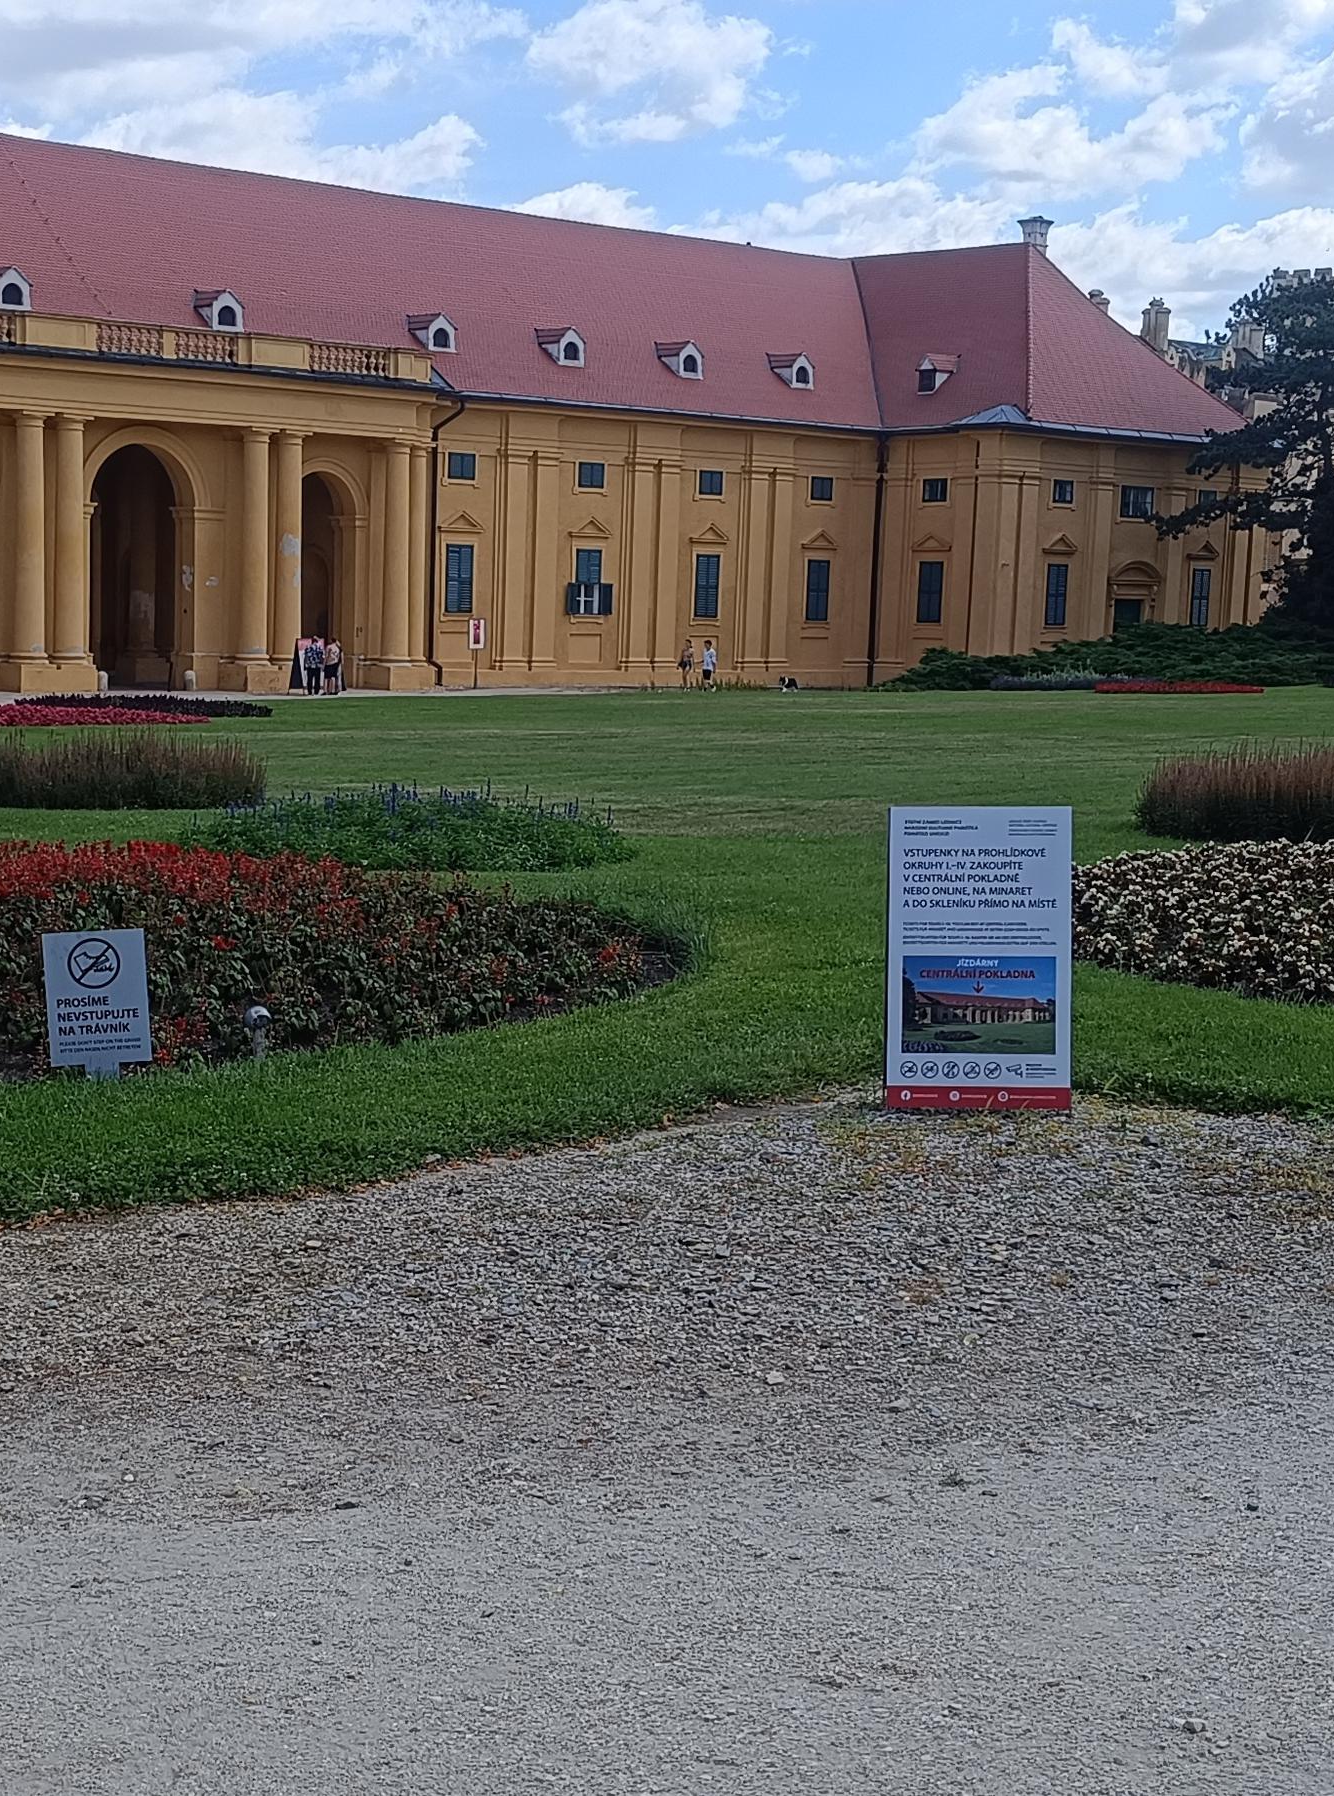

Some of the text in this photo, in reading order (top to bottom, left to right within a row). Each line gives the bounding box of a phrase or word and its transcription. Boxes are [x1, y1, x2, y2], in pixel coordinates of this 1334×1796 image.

[903, 847, 1046, 857] VSTUPENKY NA PROHLÍDKOVÉ
[903, 861, 944, 870] OKRUHY
[969, 860, 1023, 870] ZAKOUPÍTE
[903, 874, 910, 882] V
[912, 872, 965, 882] CENTRÁLNÍ
[903, 886, 1032, 896] NEBO ONLINE, NA MINARET
[903, 898, 1058, 908] A DO SKLENÍKU PŘÍMO NA MÍSTĚ
[920, 968, 1035, 978] CENTRÁLNÍ POKLADNA
[57, 995, 110, 1008] PROSÍME
[58, 1008, 139, 1022] NEVSTUPUJTE
[59, 1021, 130, 1036] NA TRÁVNÍK
